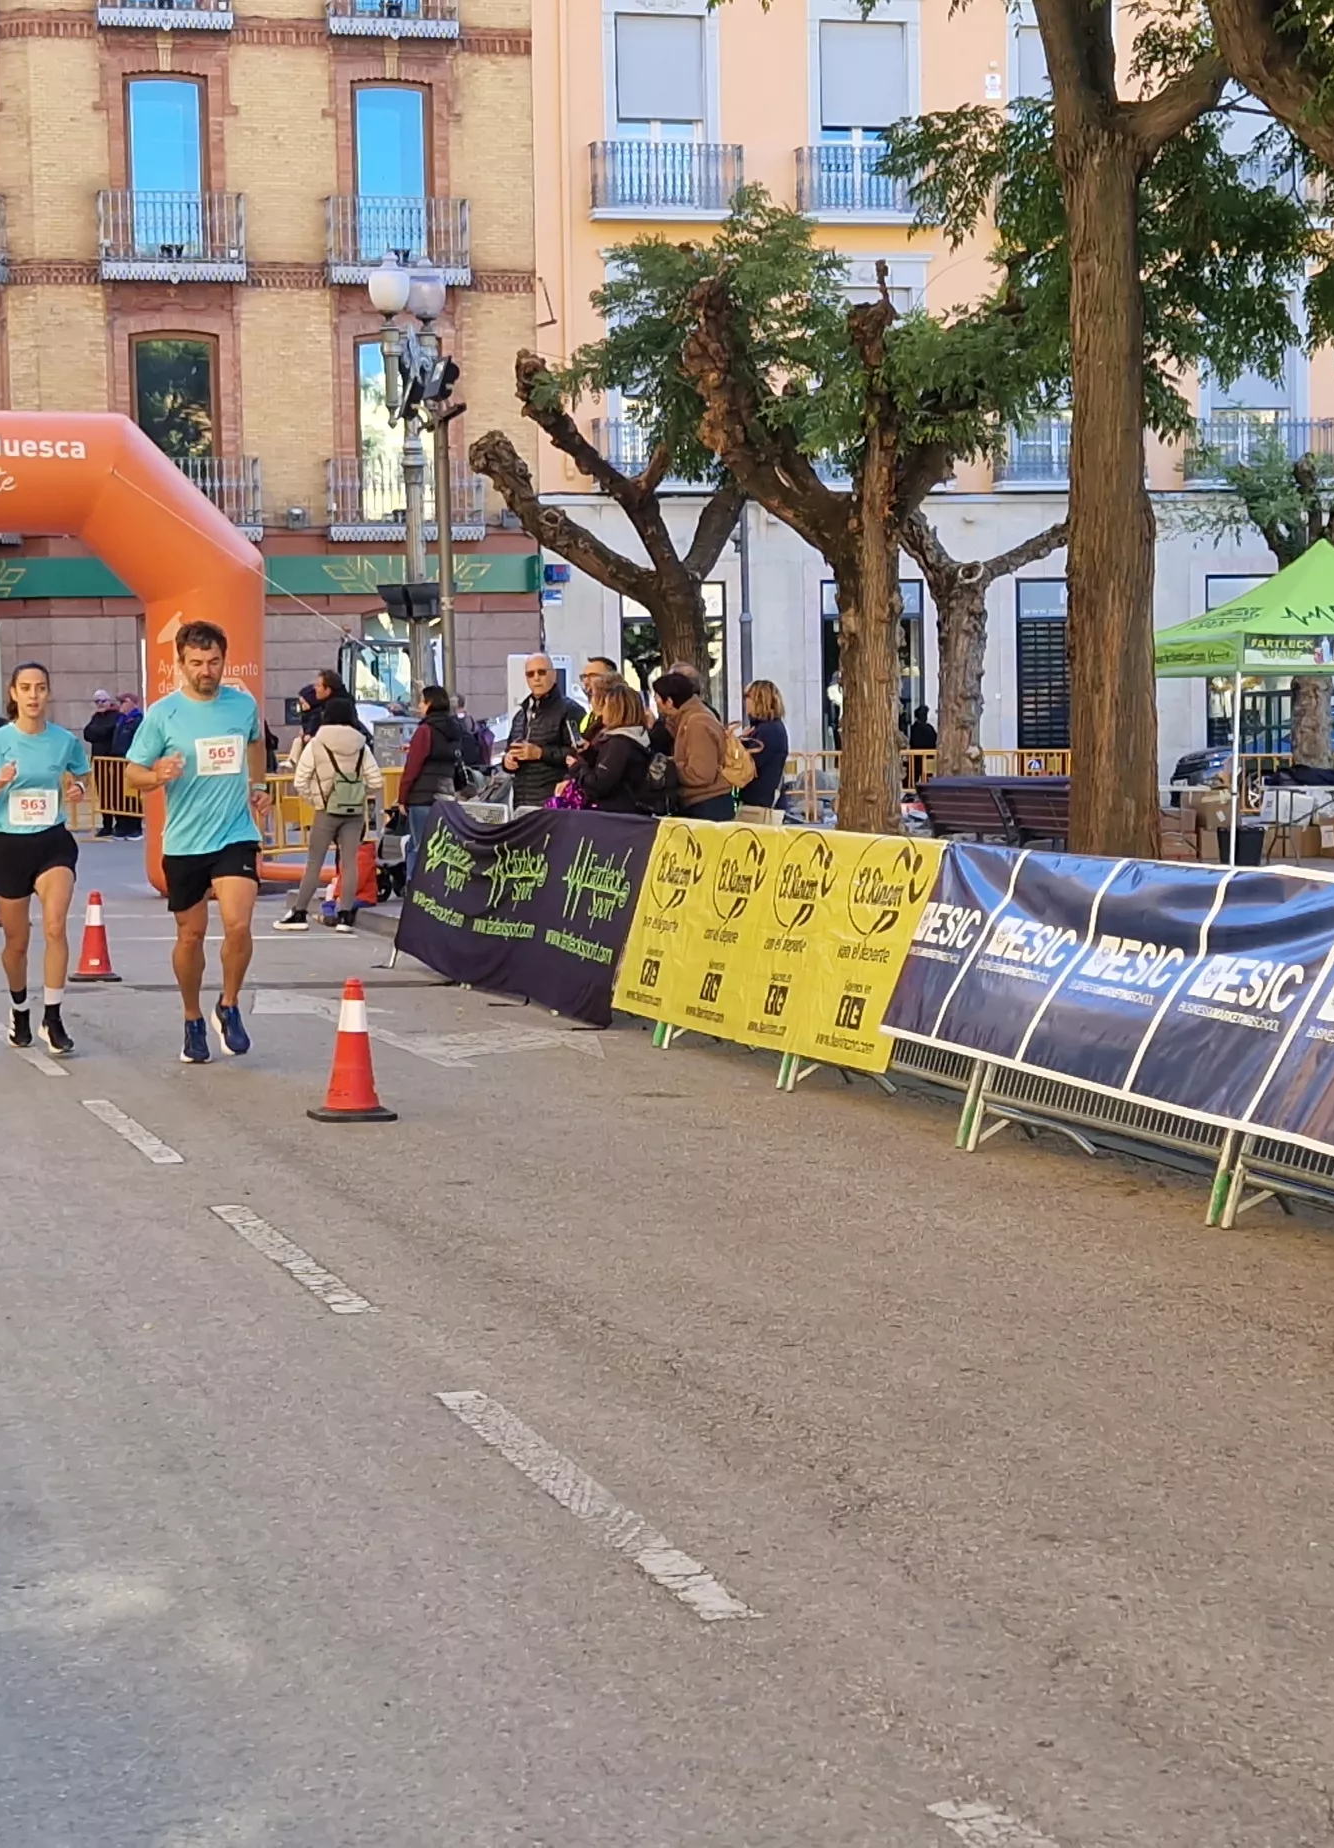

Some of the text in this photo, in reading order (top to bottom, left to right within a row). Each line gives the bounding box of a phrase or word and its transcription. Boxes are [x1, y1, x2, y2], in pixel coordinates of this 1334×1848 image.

[208, 747, 236, 760] 565
[20, 799, 47, 811] 563
[930, 904, 982, 949] ESIC
[1005, 921, 1078, 968] ESIC
[1101, 937, 1185, 989] ESIC
[1214, 958, 1305, 1013] ESIC
